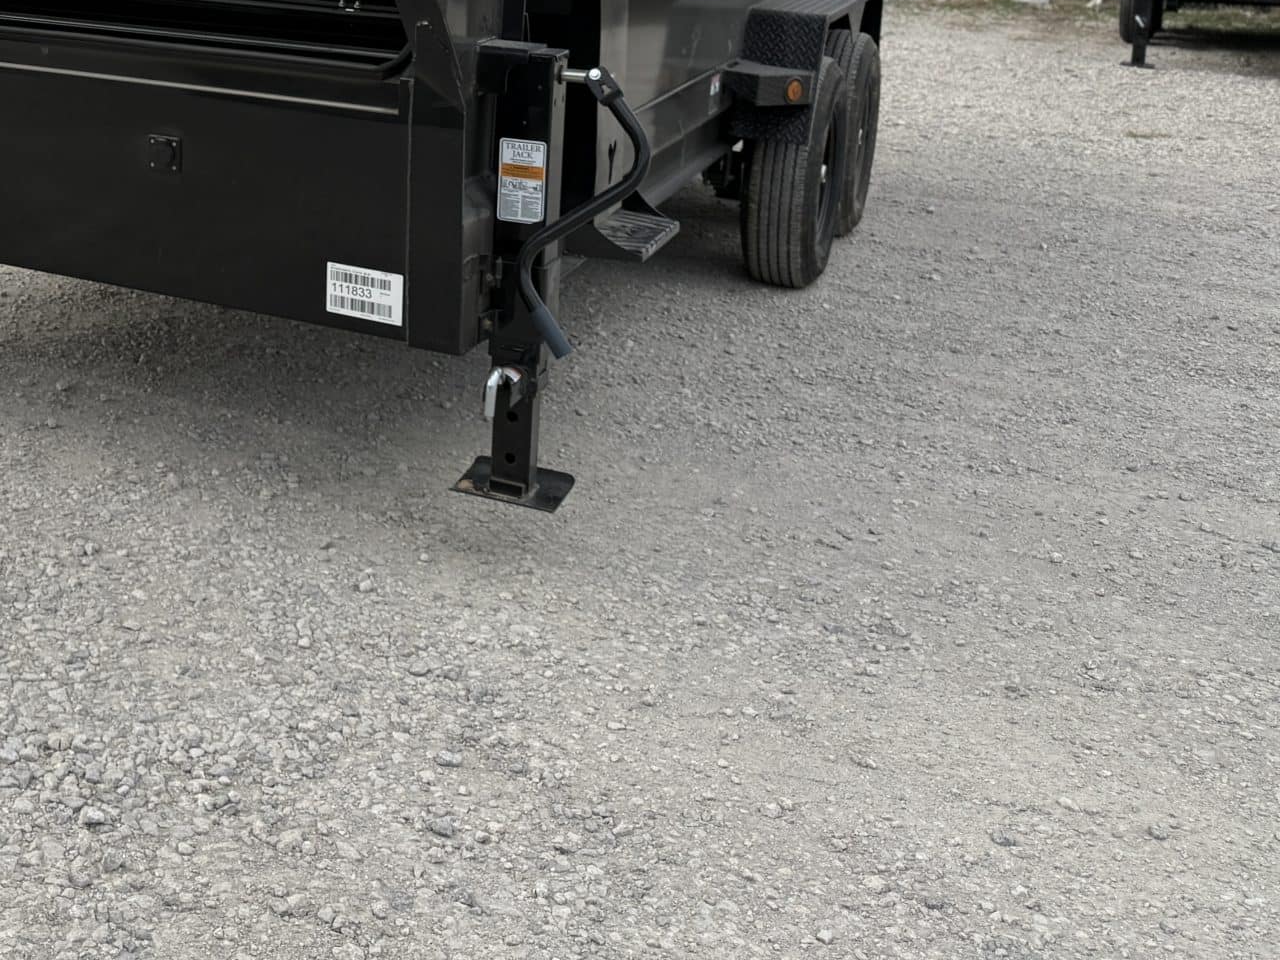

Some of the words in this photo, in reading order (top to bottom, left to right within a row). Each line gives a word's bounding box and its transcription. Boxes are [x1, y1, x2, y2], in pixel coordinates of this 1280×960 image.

[506, 143, 541, 152] TRAILER
[512, 150, 534, 159] JACK
[332, 283, 372, 298] 111833
